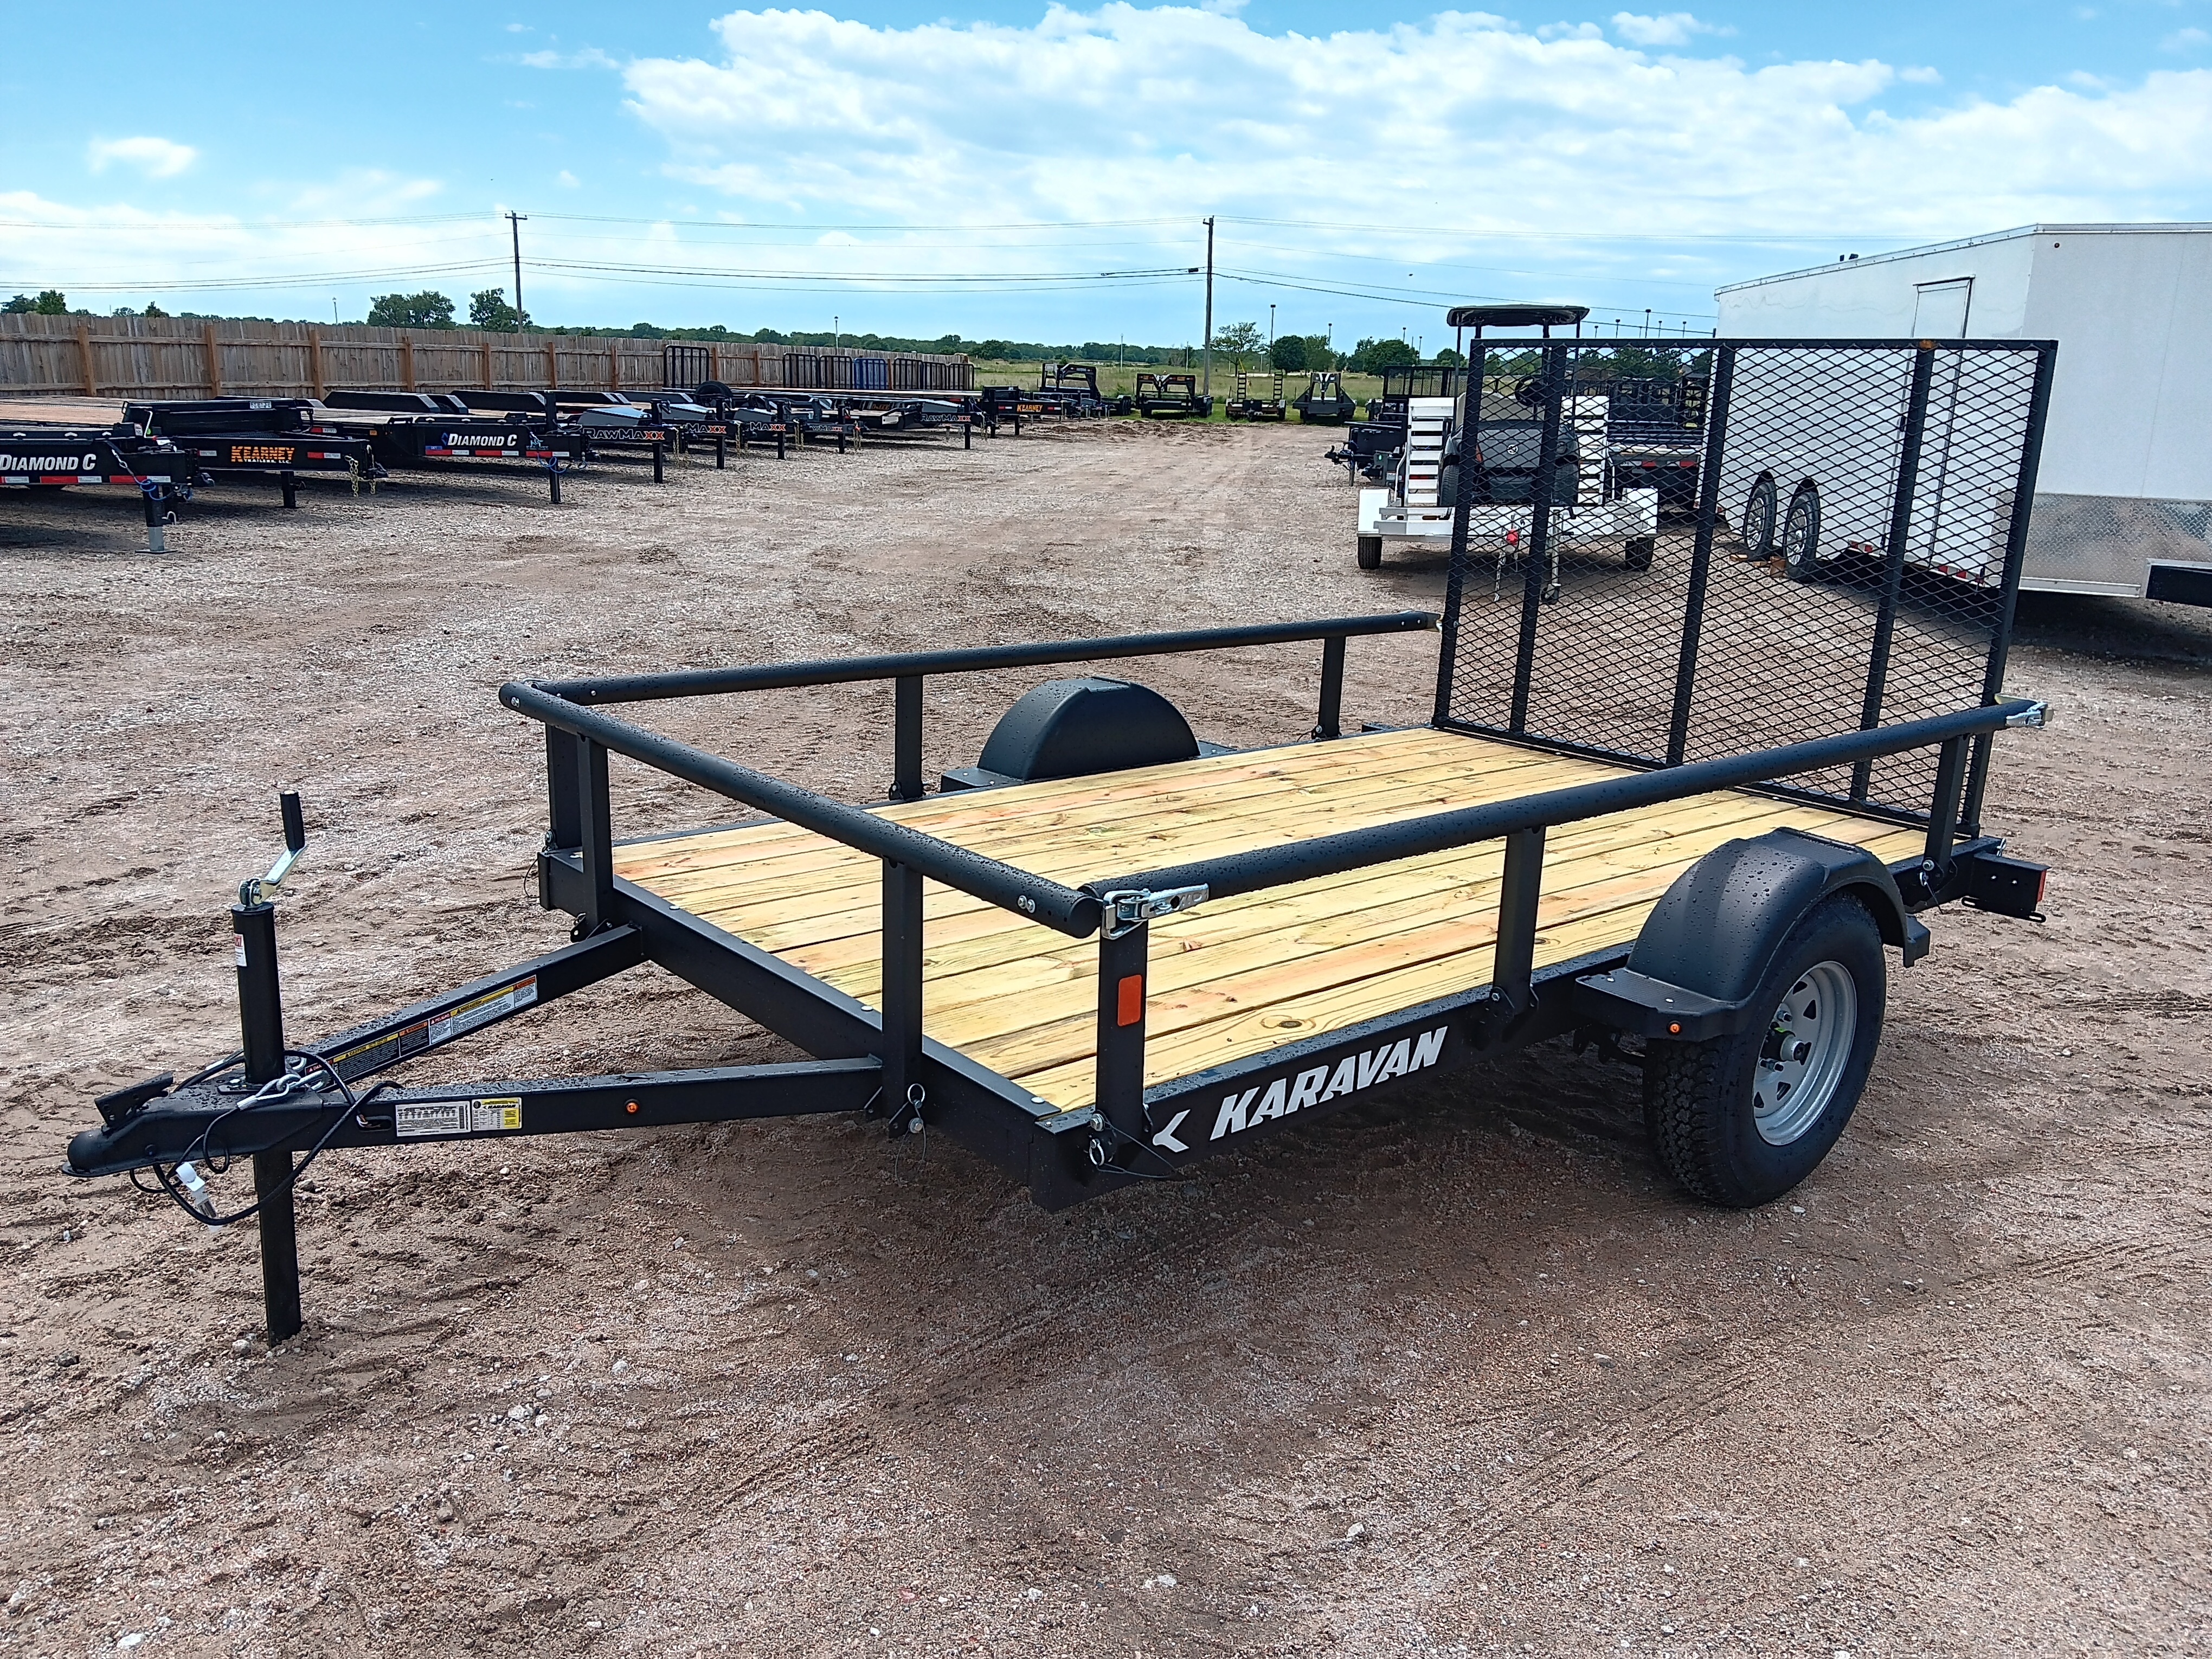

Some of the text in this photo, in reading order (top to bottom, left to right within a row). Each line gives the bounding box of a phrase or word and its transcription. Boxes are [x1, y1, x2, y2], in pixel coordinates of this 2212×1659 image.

[750, 421, 787, 432] MAXX
[447, 433, 505, 446] DIAMOND
[507, 434, 517, 446] C
[583, 428, 665, 440] RAWMAXX
[231, 446, 295, 462] KEARNEY
[0, 453, 97, 471] DIAMOND C
[349, 1045, 366, 1056] CAUTION
[1210, 1026, 1448, 1141] KARAVAN
